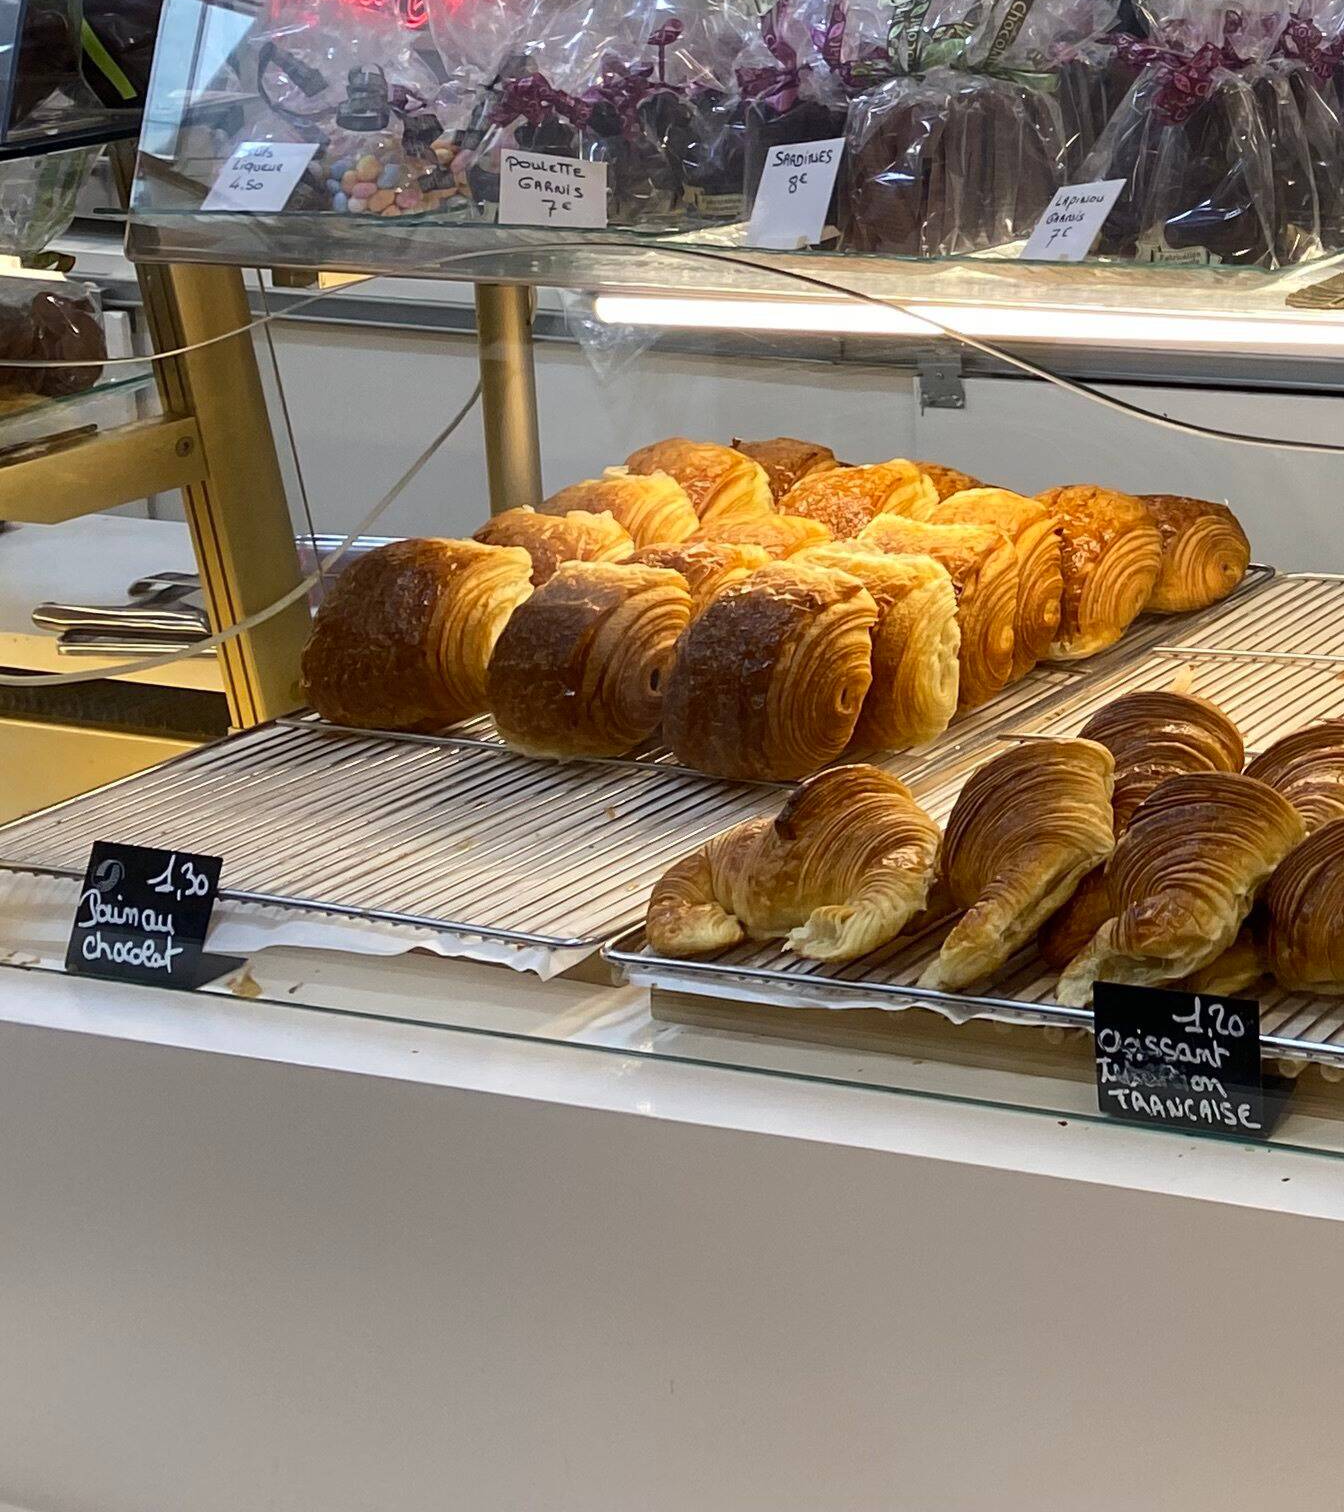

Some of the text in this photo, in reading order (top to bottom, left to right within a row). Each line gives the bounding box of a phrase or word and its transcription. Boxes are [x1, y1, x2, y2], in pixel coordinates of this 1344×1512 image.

[505, 155, 586, 179] POULETTE
[518, 176, 583, 199] GARNIS
[146, 854, 209, 901] 1,30
[78, 888, 175, 935] Pain au
[1172, 996, 1245, 1038] 1,20
